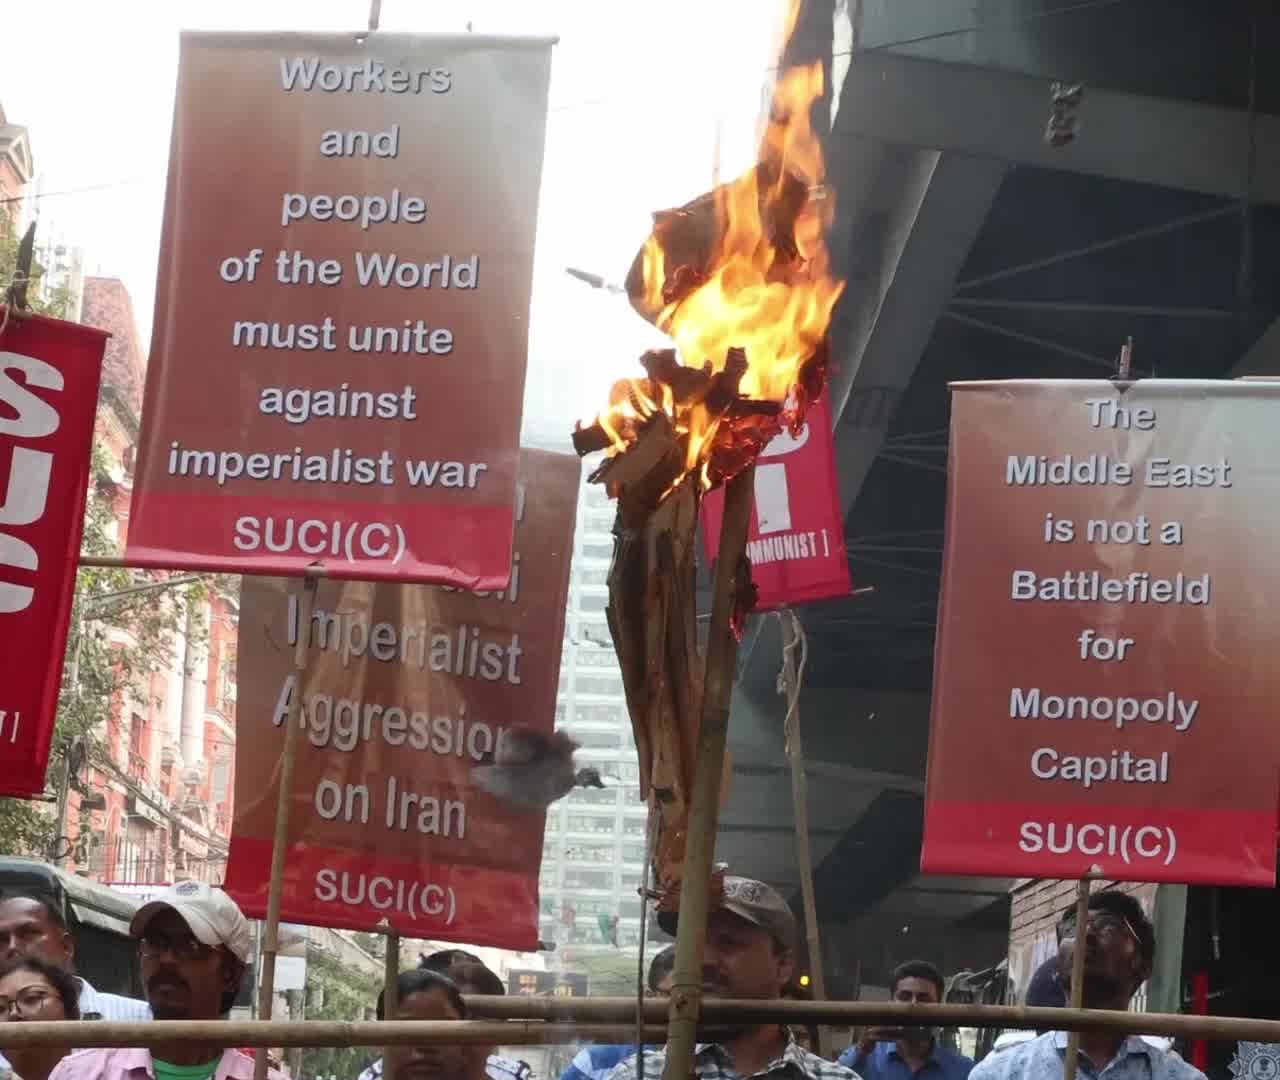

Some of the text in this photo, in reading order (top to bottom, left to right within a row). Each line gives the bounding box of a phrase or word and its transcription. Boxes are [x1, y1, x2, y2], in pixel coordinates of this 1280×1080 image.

[279, 56, 452, 95] Workers
[320, 125, 400, 158] and
[281, 190, 428, 230] people
[220, 249, 480, 291] of the World
[232, 317, 454, 356] must unite
[259, 383, 417, 426] against
[1085, 399, 1157, 430] The
[167, 442, 488, 490] imperialist war
[1005, 455, 1232, 487] Middle East
[233, 516, 407, 564] SUCI(C)
[1044, 514, 1183, 545] is not a
[1011, 571, 1210, 604] Battlefield
[288, 594, 522, 684] Imperialist
[1078, 631, 1134, 661] for
[1009, 689, 1198, 731] Monopoly
[1031, 749, 1169, 787] Capital
[315, 776, 465, 839] on Iran
[1019, 823, 1178, 864] SUCI(C)
[314, 869, 456, 925] SUCI(C)
